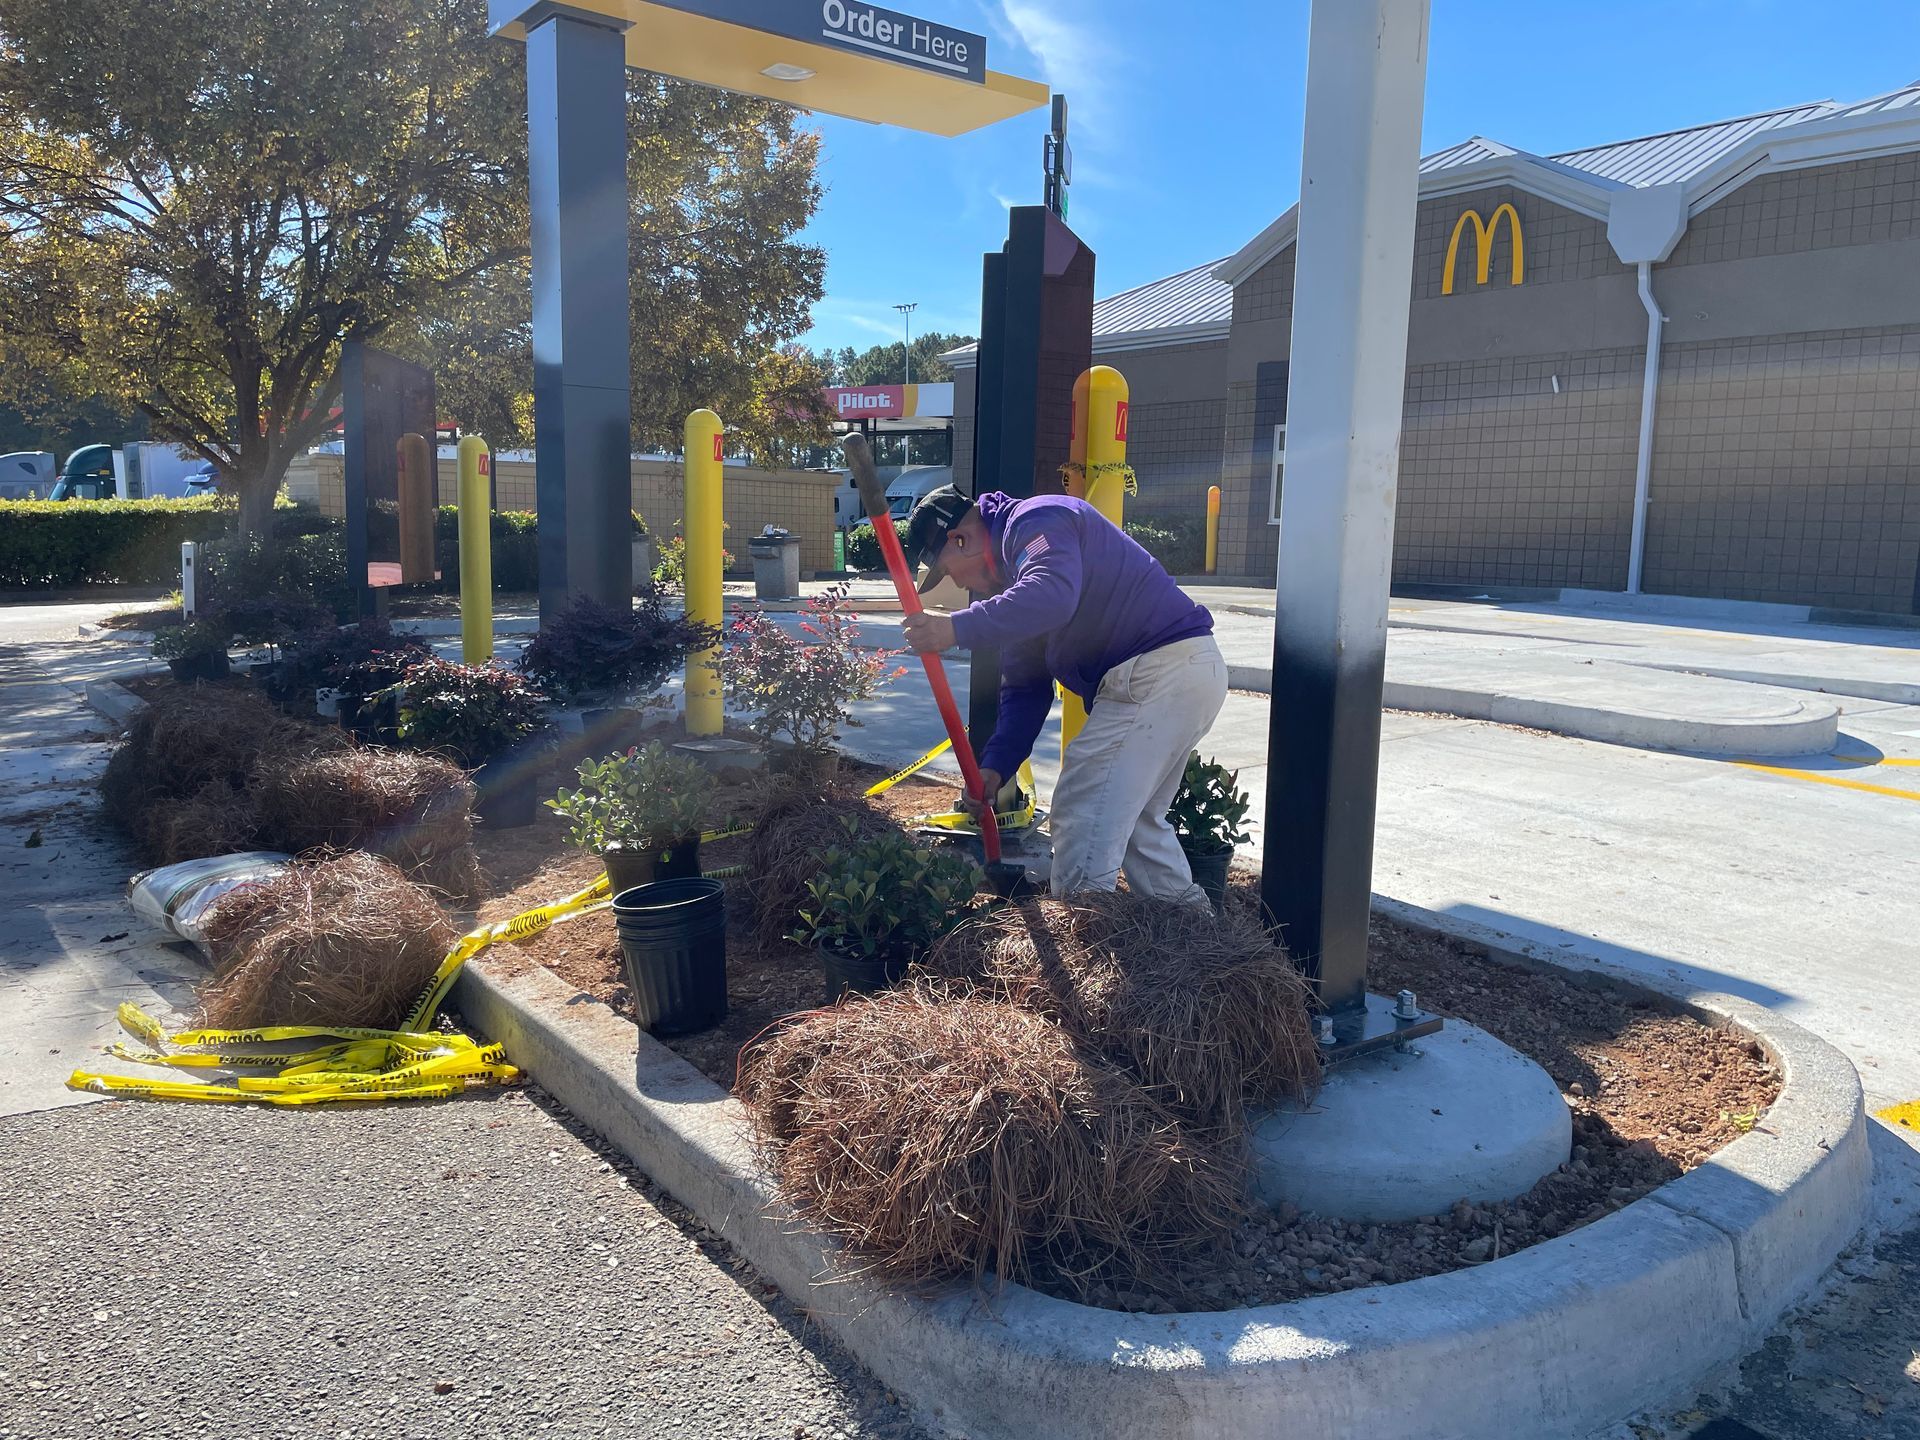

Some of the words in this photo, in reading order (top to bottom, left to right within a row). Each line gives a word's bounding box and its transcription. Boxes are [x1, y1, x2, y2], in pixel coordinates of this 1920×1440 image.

[823, 0, 903, 45] Order
[912, 22, 968, 62] Here
[838, 393, 890, 413] Pilot
[504, 912, 548, 937] CAUTION
